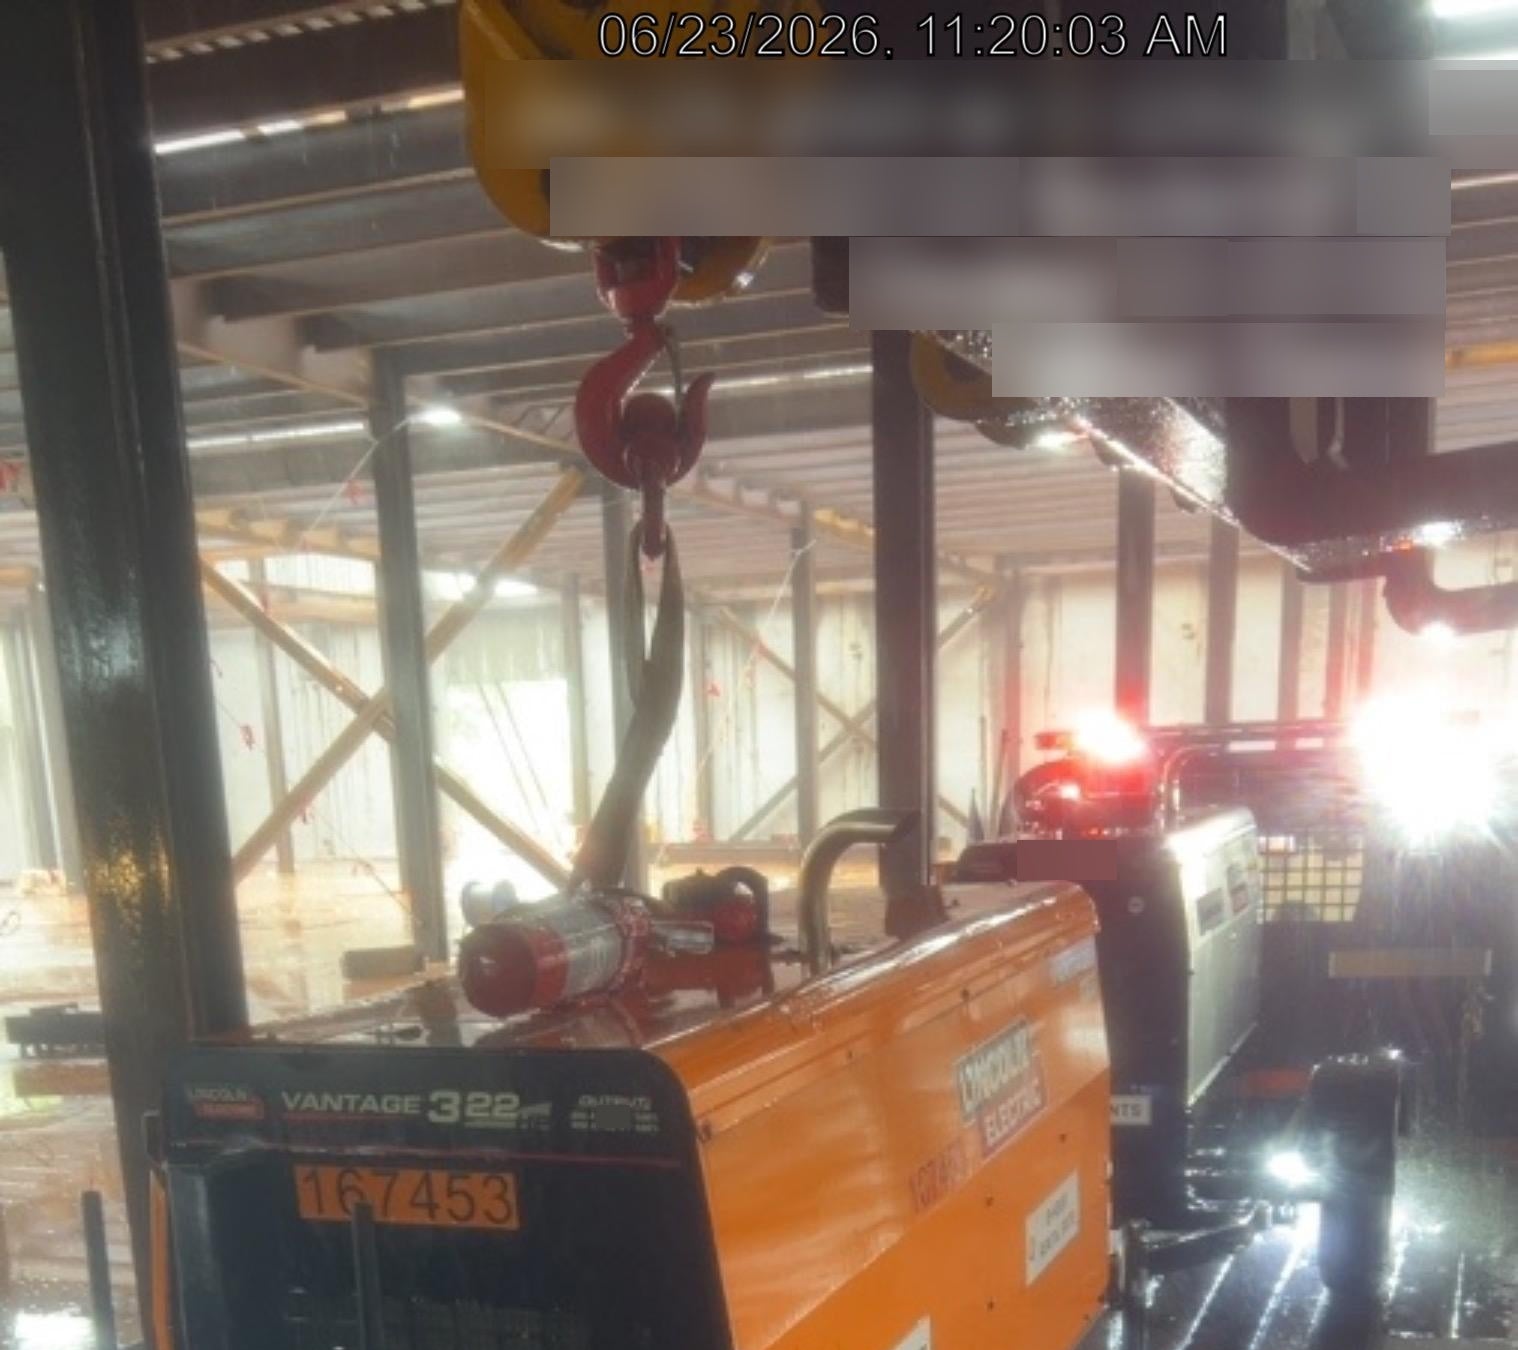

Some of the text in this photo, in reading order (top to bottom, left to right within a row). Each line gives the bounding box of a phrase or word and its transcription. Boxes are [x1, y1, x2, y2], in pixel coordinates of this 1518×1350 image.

[281, 1091, 420, 1114] VANTAGE
[428, 1091, 520, 1122] 322
[302, 1168, 513, 1225] 167453
